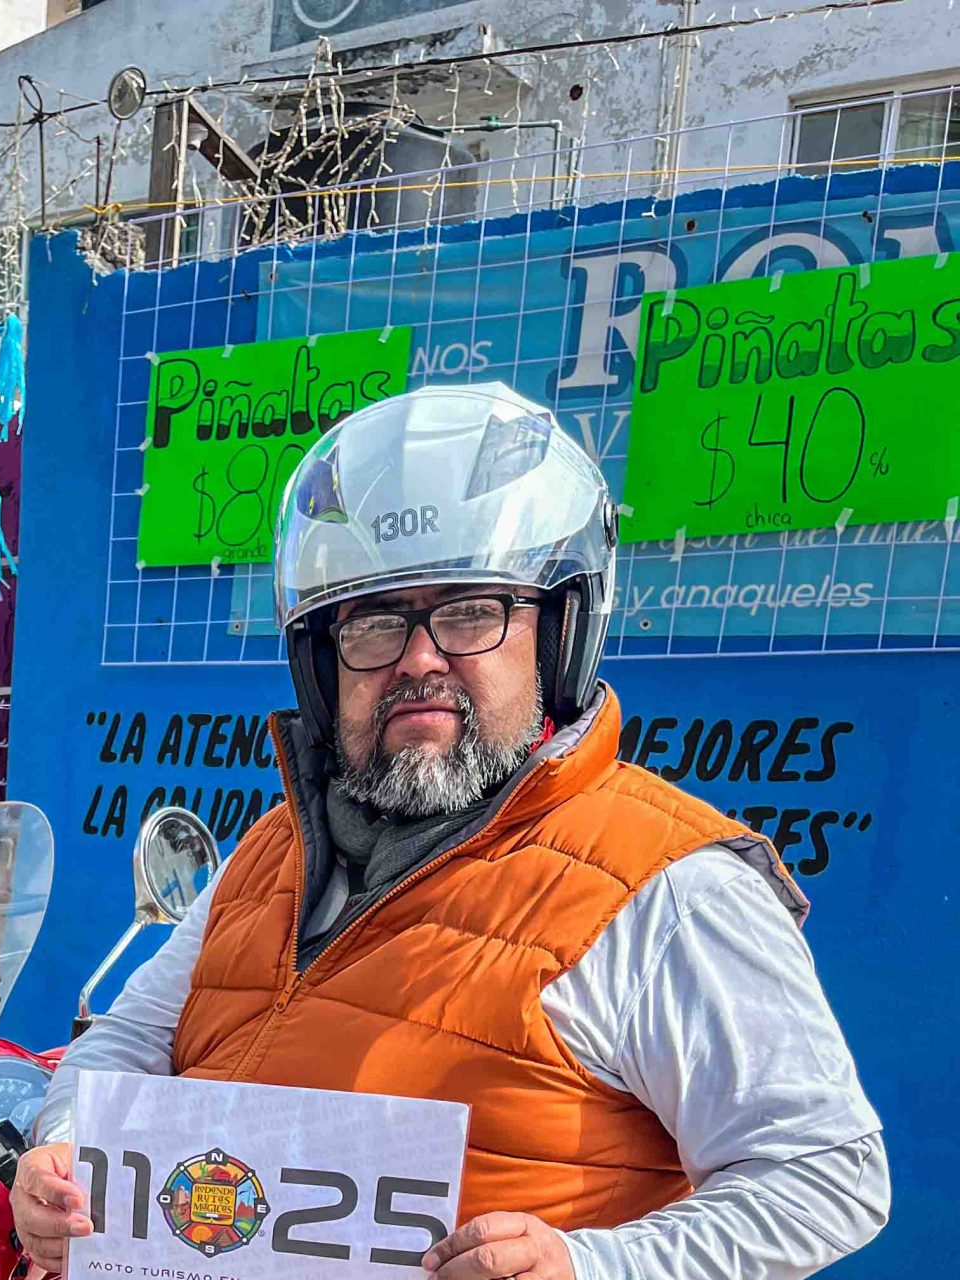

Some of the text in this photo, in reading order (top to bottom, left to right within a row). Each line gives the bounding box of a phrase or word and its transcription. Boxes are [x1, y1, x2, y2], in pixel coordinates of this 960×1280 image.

[641, 272, 960, 393] Piñatas
[694, 387, 866, 512] $40
[370, 503, 440, 544] 130R
[745, 502, 793, 528] chica
[660, 574, 874, 616] anaqueles
[157, 713, 280, 768] ATENC
[83, 784, 127, 838] LA
[271, 1167, 450, 1267] 25
[88, 1260, 133, 1274] MOTO
